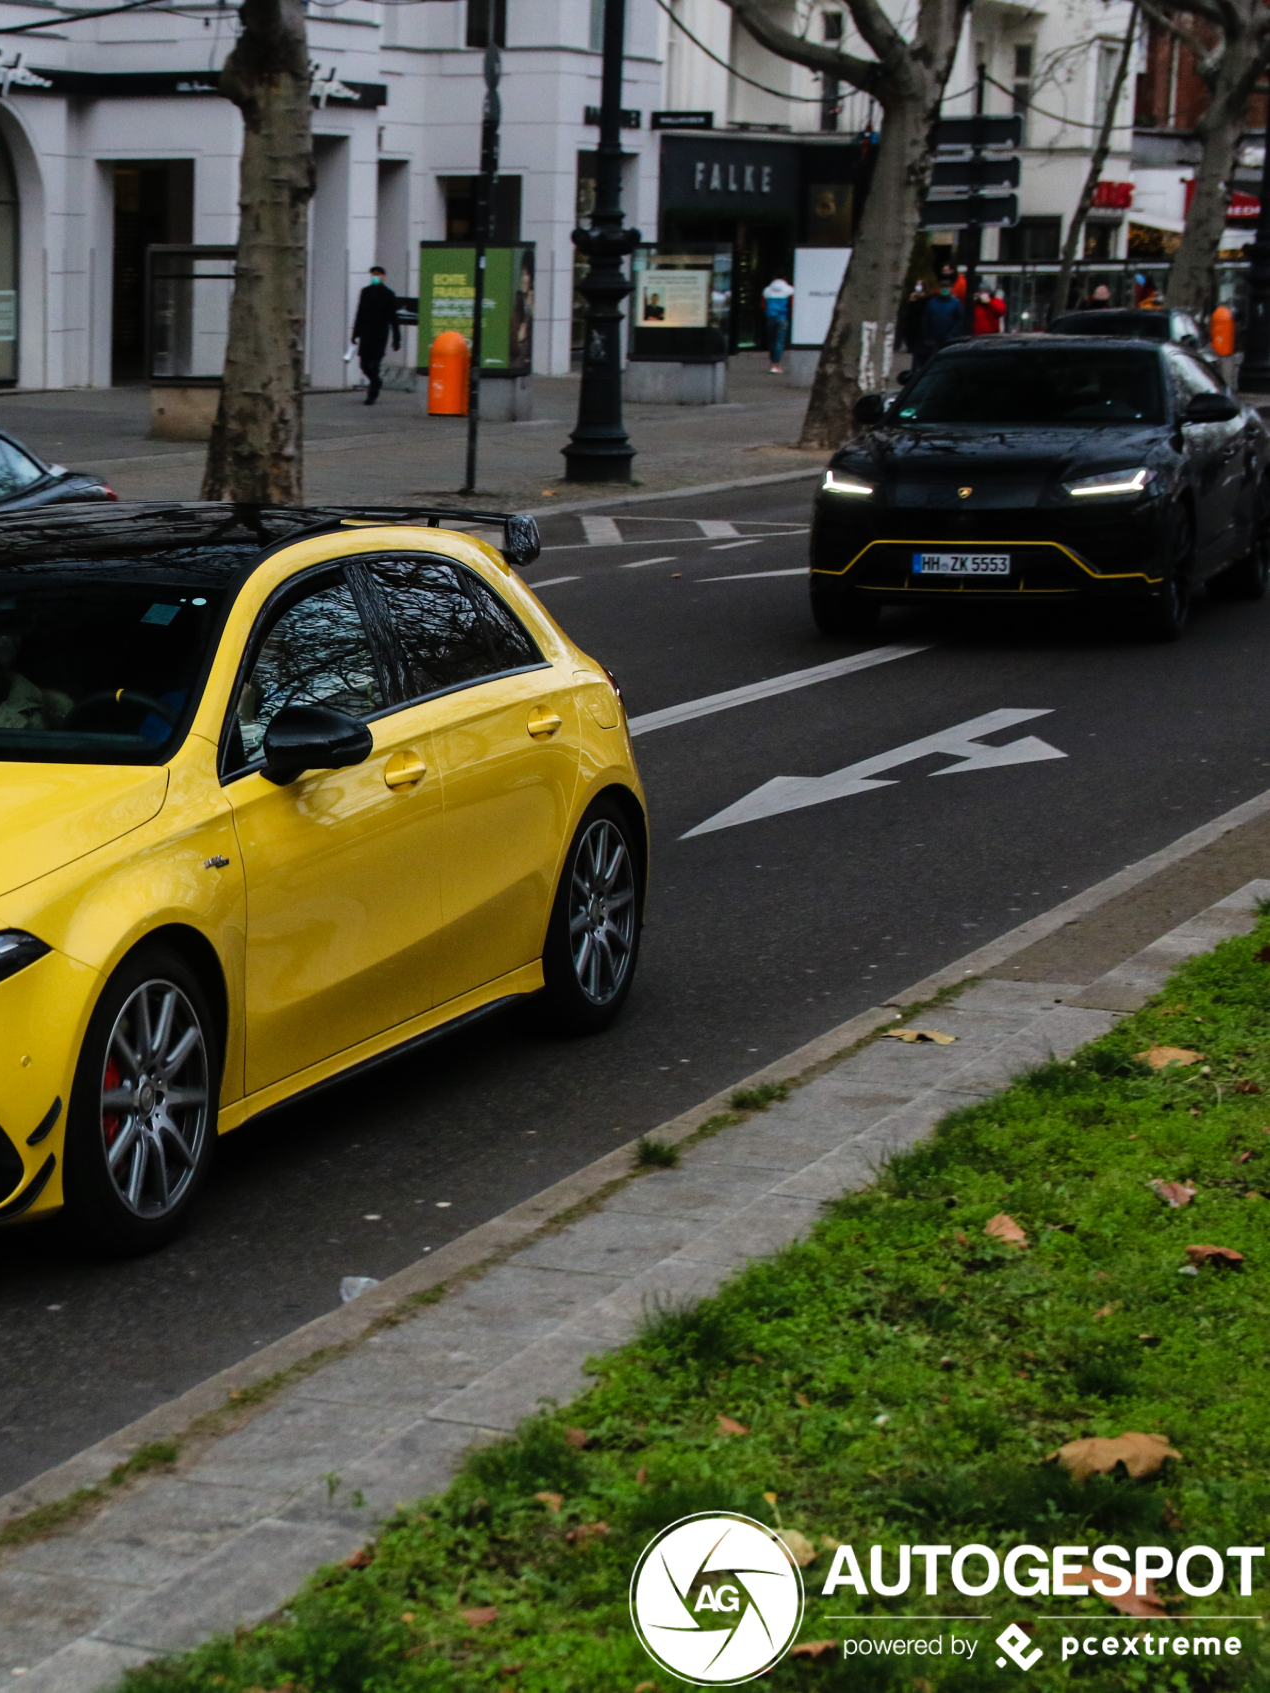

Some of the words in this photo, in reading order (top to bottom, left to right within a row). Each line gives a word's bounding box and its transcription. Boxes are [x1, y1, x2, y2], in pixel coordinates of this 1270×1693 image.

[694, 162, 772, 194] FALKE
[922, 556, 940, 571] HH
[951, 556, 969, 572] ZK
[972, 557, 1008, 572] 5553
